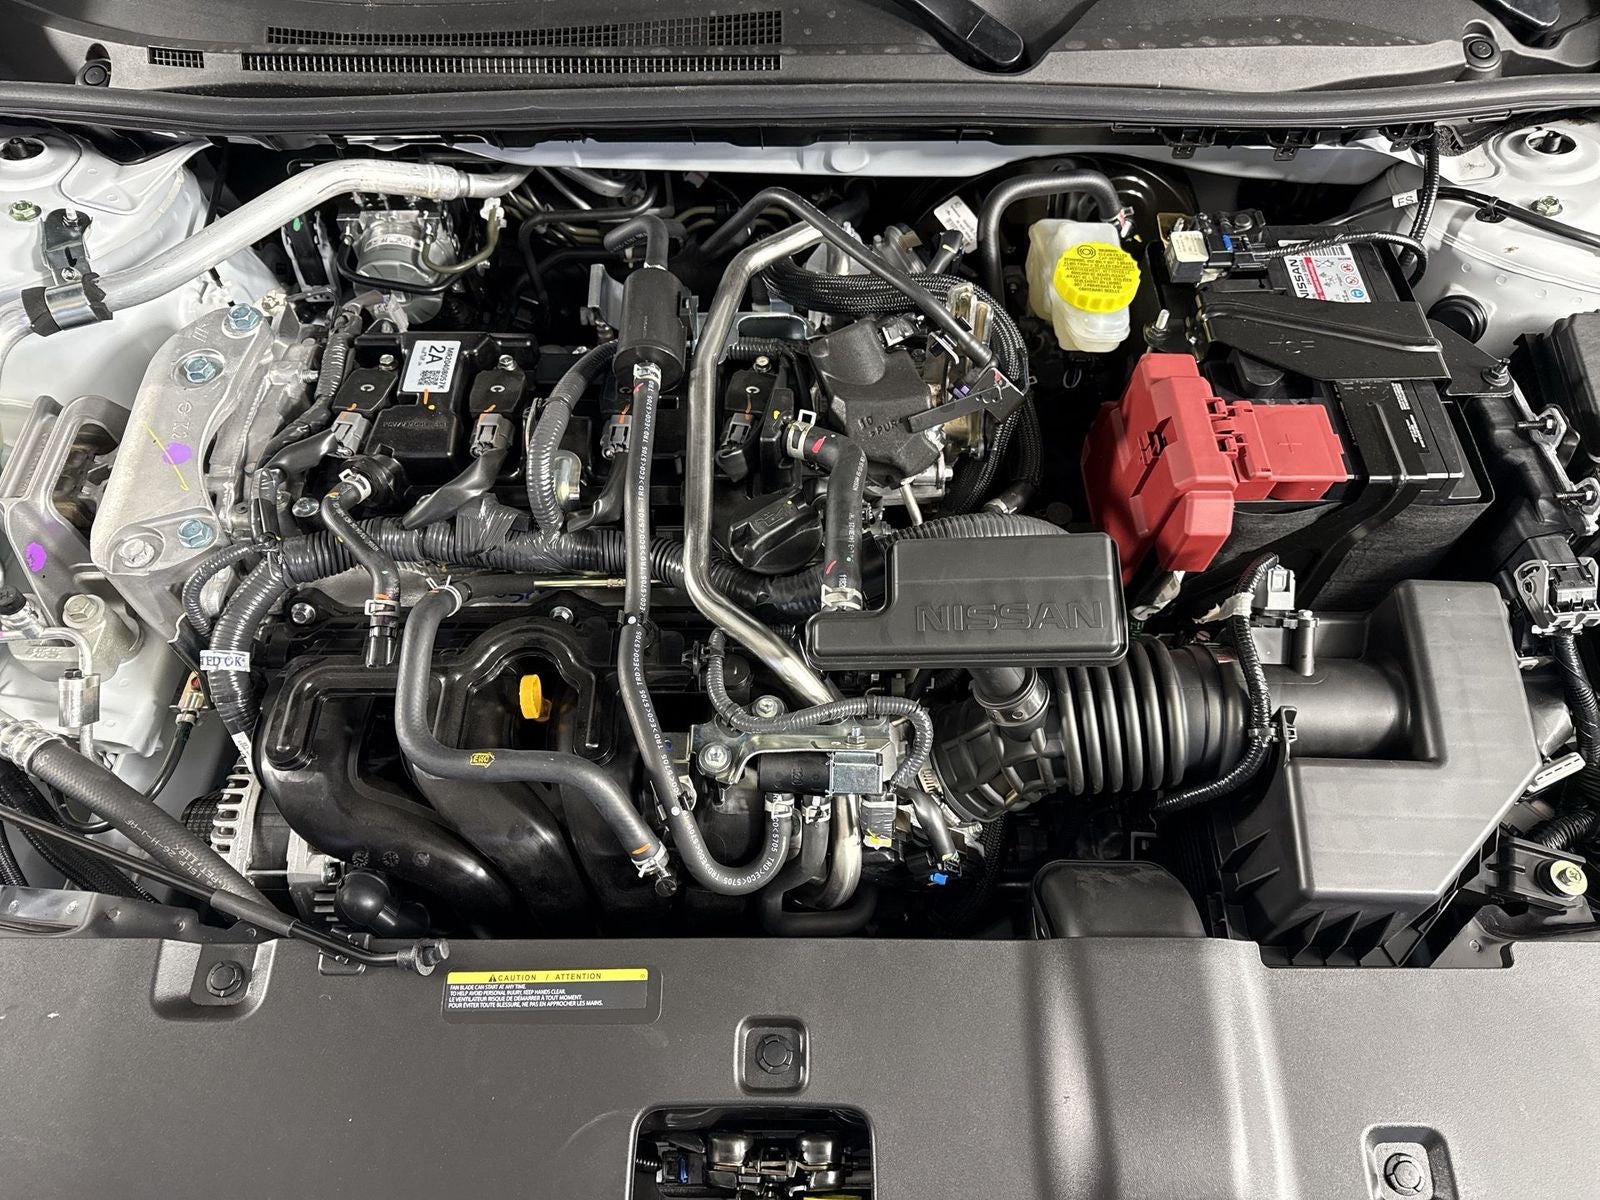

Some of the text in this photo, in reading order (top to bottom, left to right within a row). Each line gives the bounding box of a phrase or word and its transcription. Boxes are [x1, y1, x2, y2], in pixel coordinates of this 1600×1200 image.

[426, 345, 447, 364] 2A
[915, 601, 1104, 632] NISSAN
[498, 974, 536, 982] CAUTION
[555, 972, 602, 980] ATTENTION
